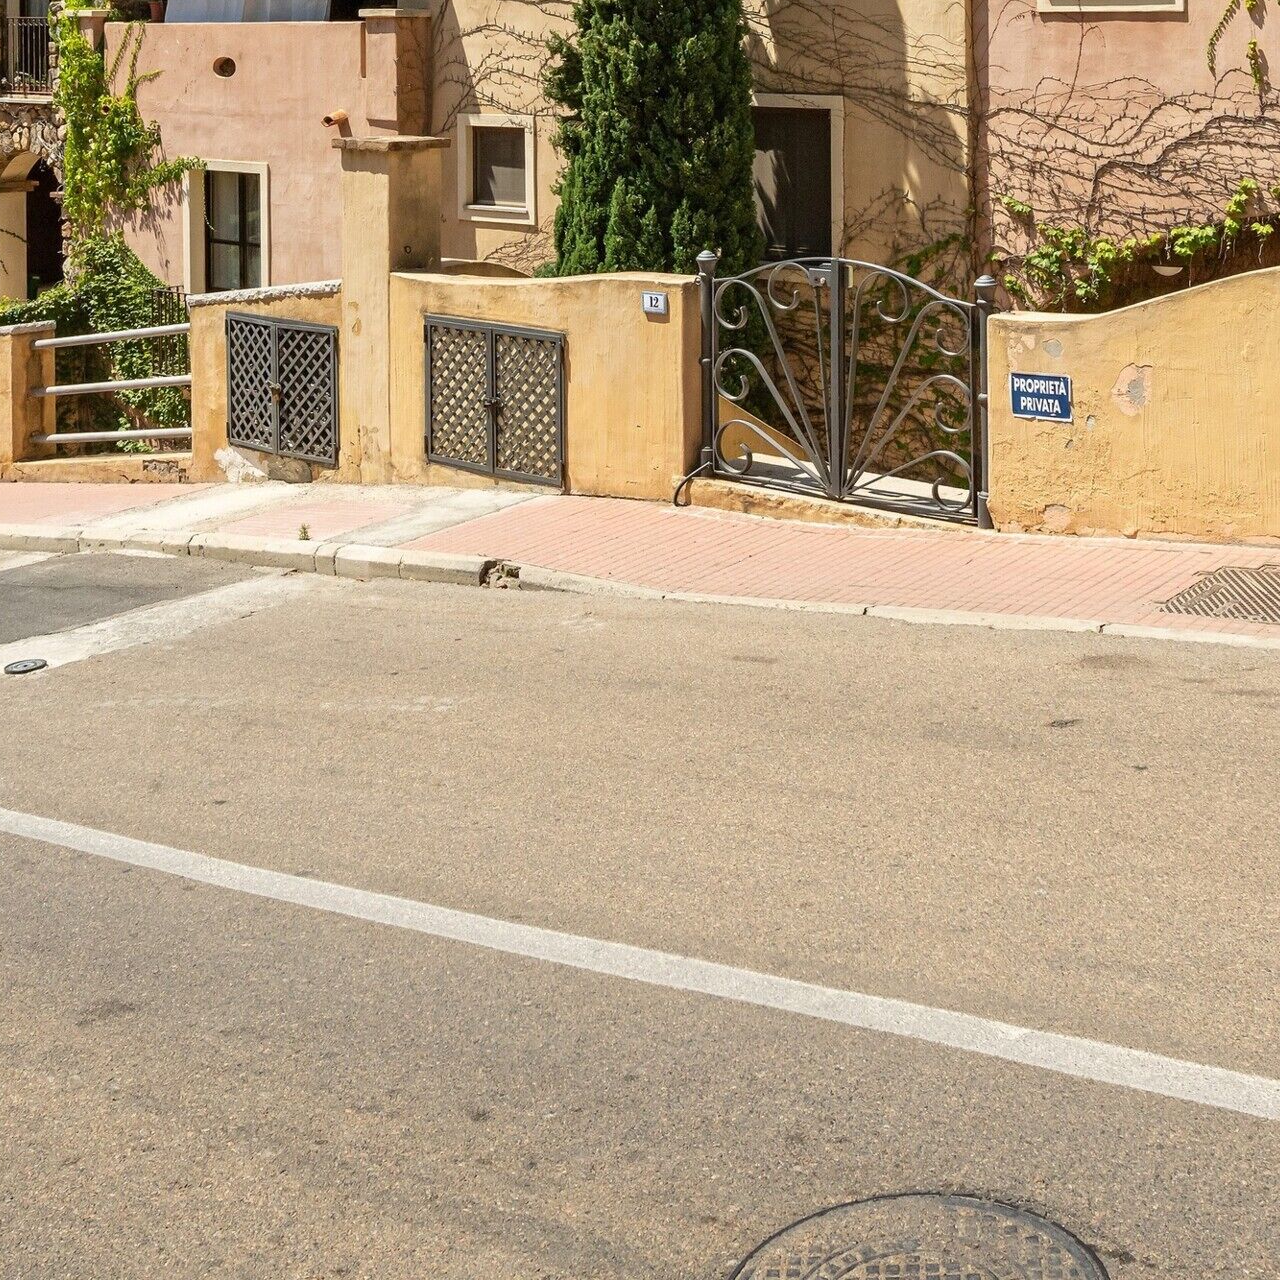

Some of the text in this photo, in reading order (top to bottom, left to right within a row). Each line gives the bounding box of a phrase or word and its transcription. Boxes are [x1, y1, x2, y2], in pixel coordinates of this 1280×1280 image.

[649, 296, 659, 308] 12
[1013, 377, 1067, 396] PROPRIETÀ
[1020, 397, 1062, 414] PRIVATA
